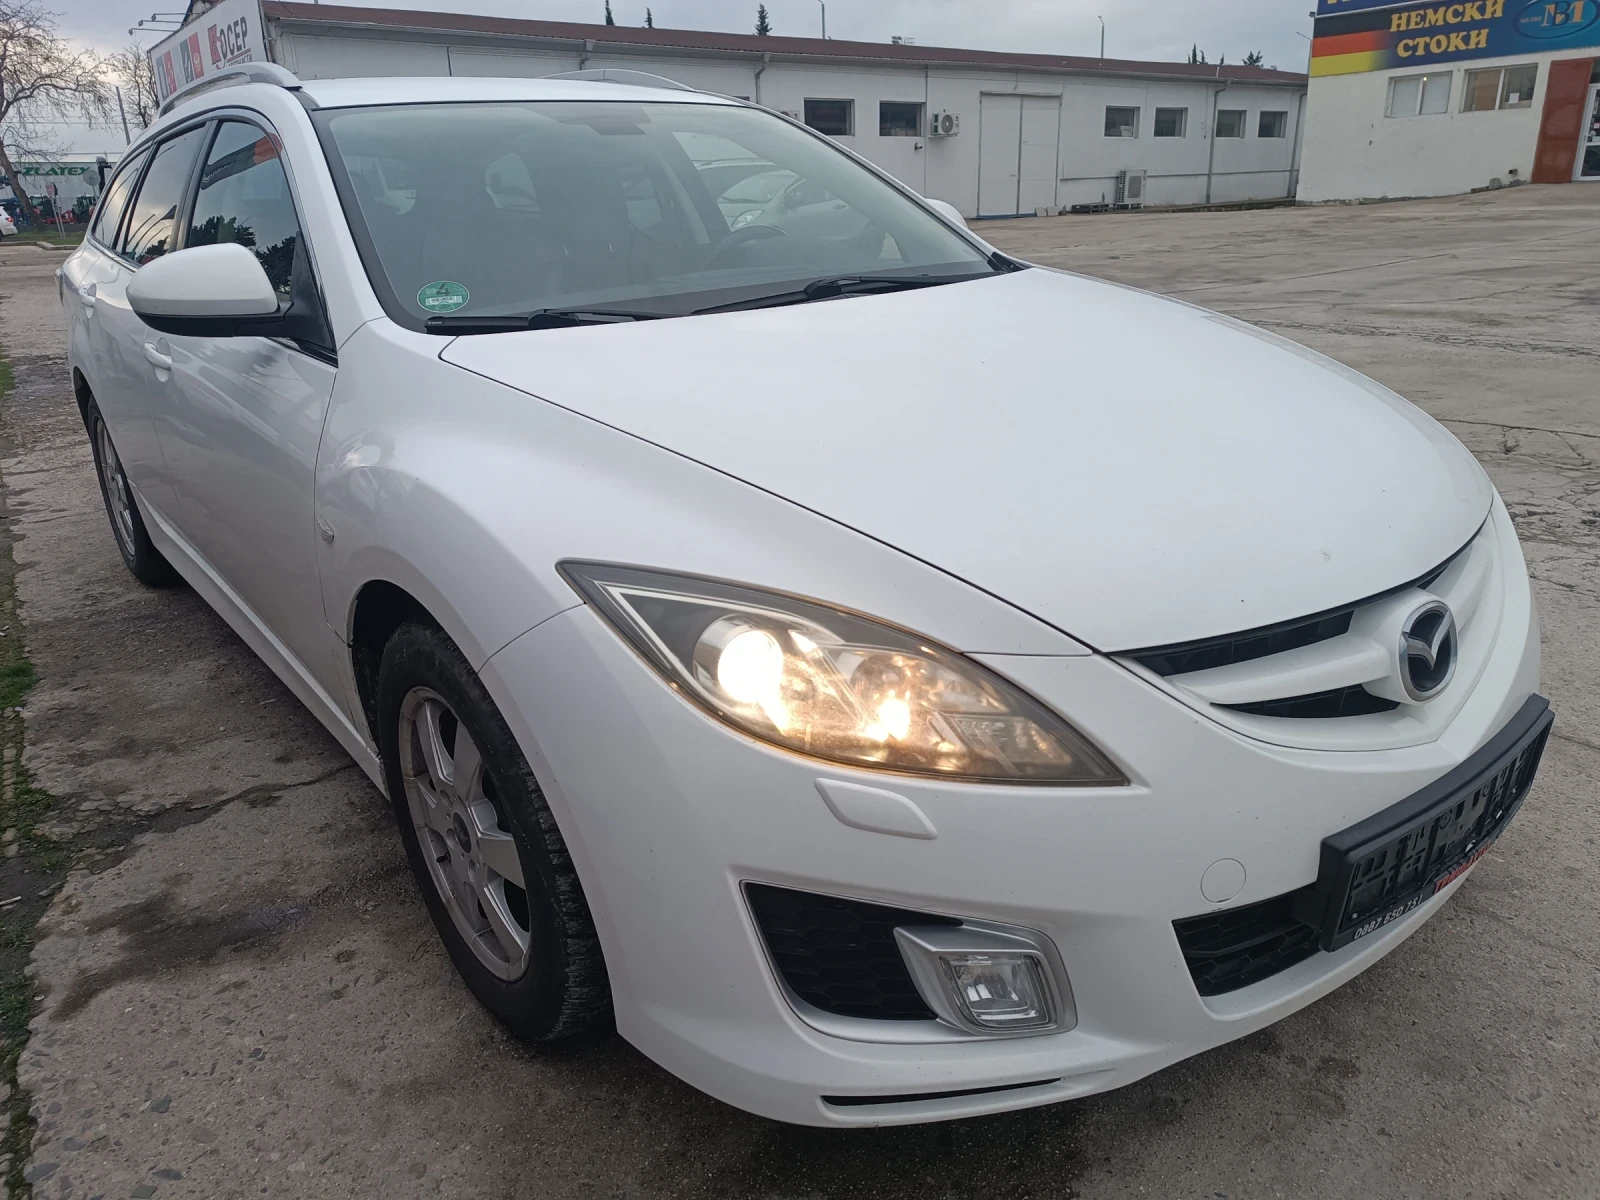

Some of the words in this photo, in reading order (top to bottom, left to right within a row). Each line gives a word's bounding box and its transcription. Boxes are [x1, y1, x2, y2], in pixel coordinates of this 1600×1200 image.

[1389, 0, 1505, 32] НЕМСКИ
[1397, 28, 1489, 58] СТОКИ
[436, 282, 450, 296] 4
[1354, 917, 1382, 940] 0887
[1383, 906, 1404, 924] 650
